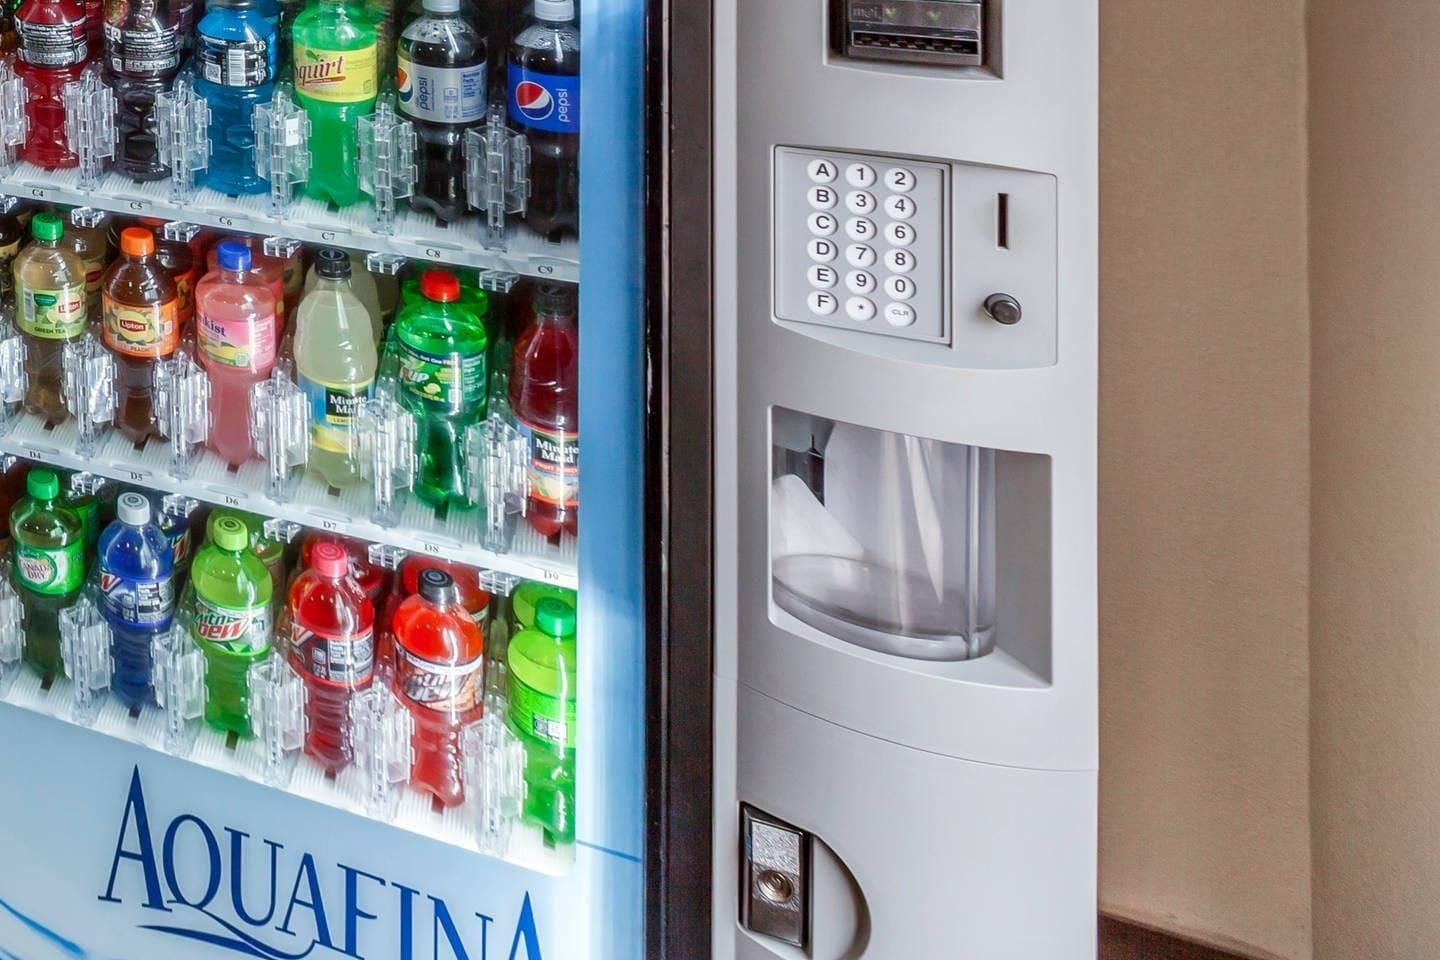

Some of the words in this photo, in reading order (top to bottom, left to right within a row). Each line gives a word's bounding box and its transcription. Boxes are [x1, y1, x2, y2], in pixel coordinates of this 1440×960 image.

[418, 76, 430, 110] pepsi
[558, 88, 570, 122] pepsi
[816, 163, 830, 177] A
[858, 168, 865, 180] 1
[894, 172, 906, 185] 2
[32, 189, 44, 198] C4
[130, 202, 142, 210] C5
[816, 190, 830, 203] B
[856, 194, 866, 208] 3
[894, 198, 906, 212] 4
[220, 216, 232, 226] C6
[816, 216, 830, 229] C
[856, 221, 867, 234] 5
[895, 225, 906, 238] 6
[321, 231, 336, 241] C7
[426, 248, 441, 258] C8
[816, 242, 830, 256] D
[856, 248, 867, 260] 7
[894, 252, 906, 266] 8
[538, 265, 553, 275] C9
[817, 268, 829, 282] E
[856, 274, 866, 287] 9
[895, 279, 906, 292] 0
[60, 302, 80, 314] Lpton
[817, 295, 828, 308] F
[892, 309, 909, 317] CLR
[122, 321, 145, 330] Lipton
[29, 450, 42, 459] D4
[130, 472, 143, 481] D5
[225, 496, 239, 506] D6
[323, 521, 337, 530] D7
[424, 544, 440, 554] D8
[544, 570, 558, 580] D9
